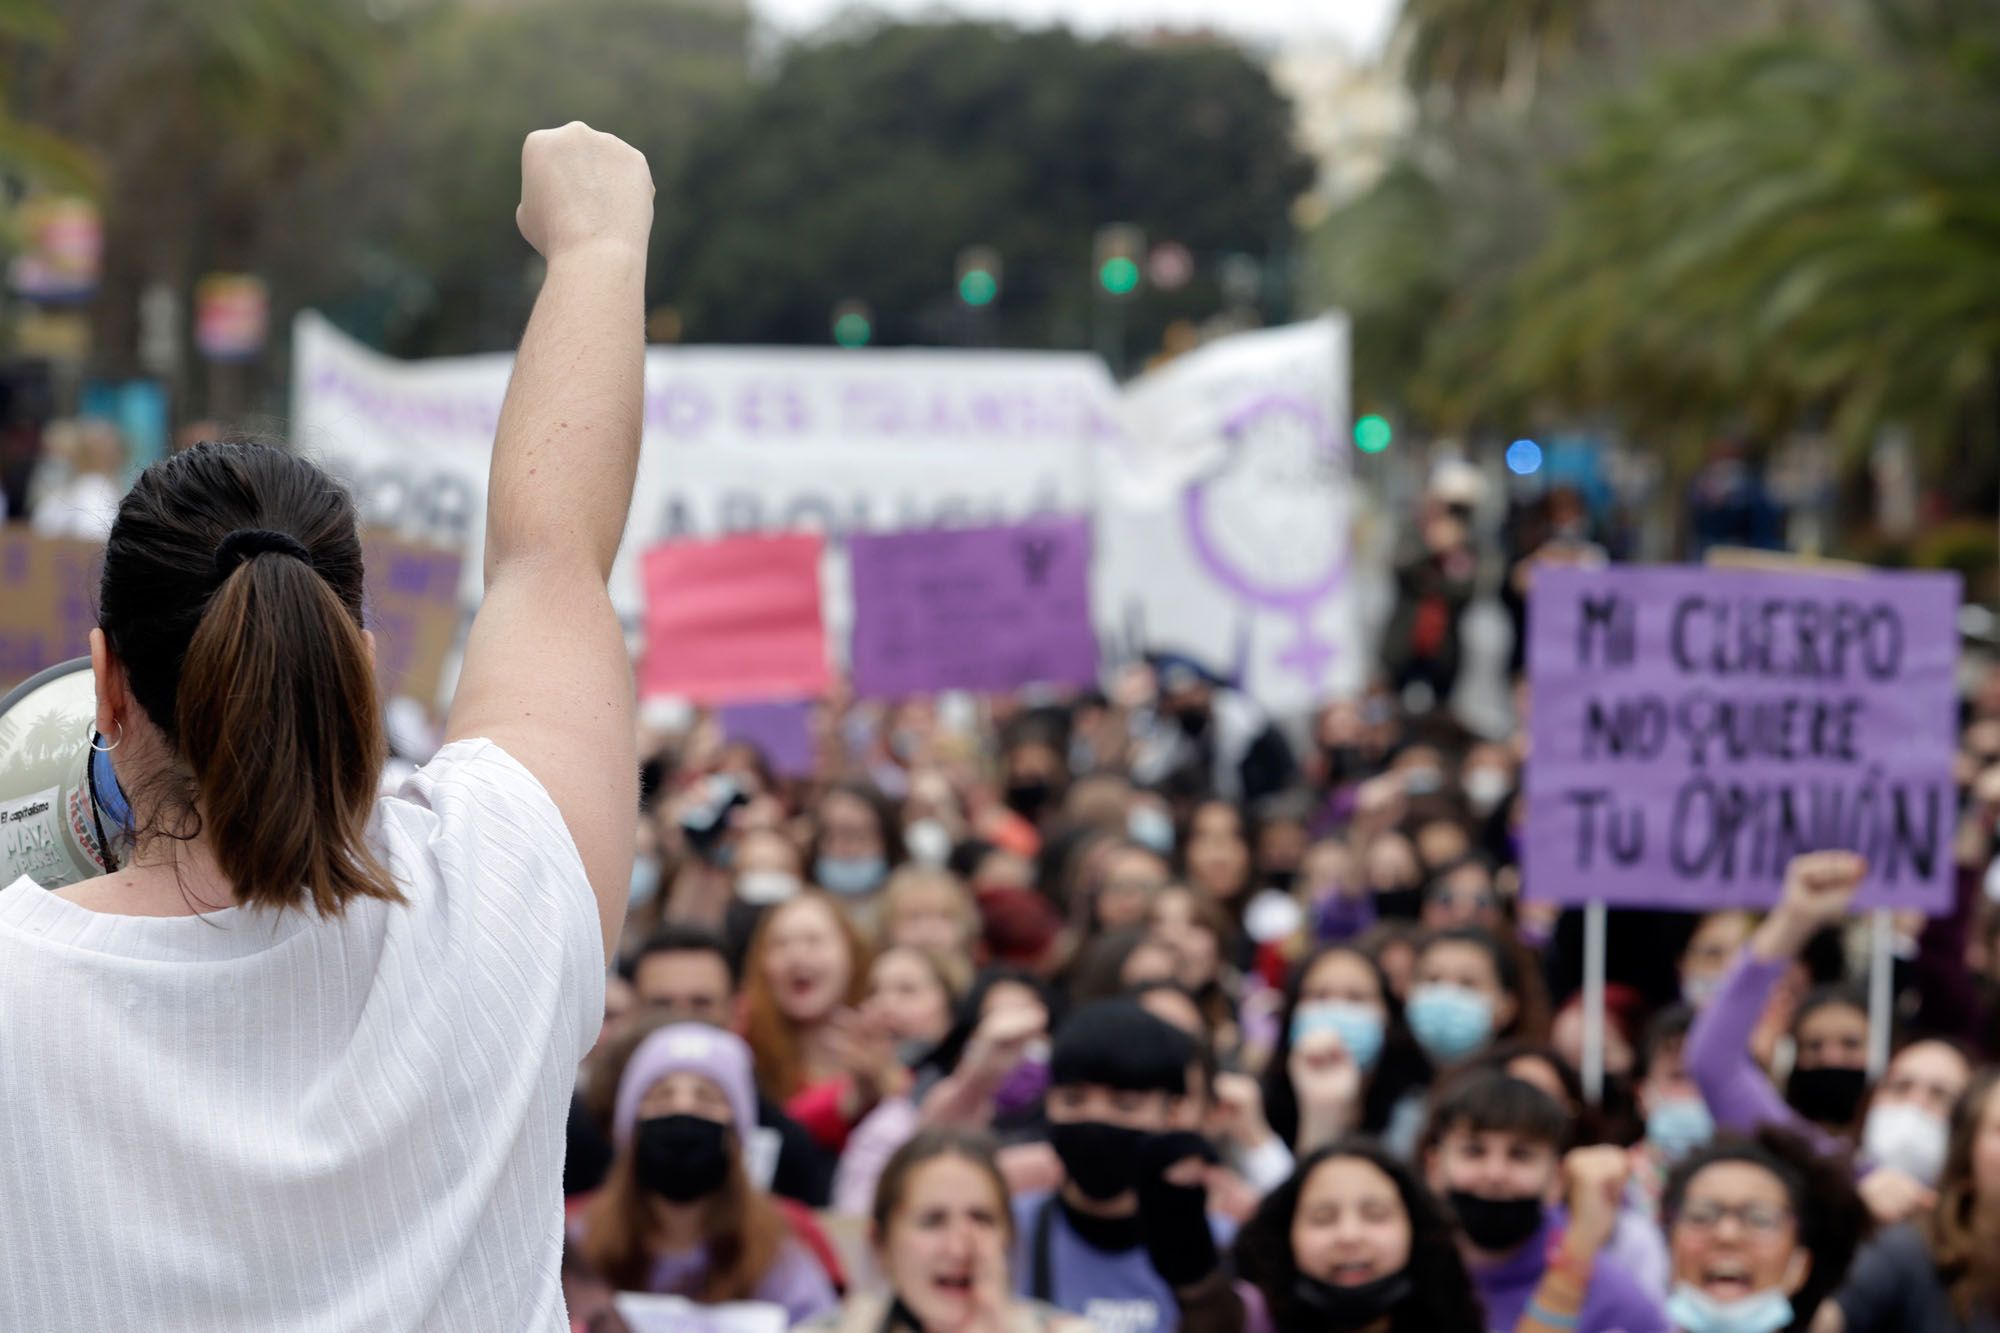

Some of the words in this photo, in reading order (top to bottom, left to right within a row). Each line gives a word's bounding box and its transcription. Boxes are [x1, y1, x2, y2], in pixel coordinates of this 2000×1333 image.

[1576, 589, 1637, 666] MI
[1669, 594, 1905, 682] CUERPO
[1581, 693, 1668, 762] NO
[10, 802, 49, 822] capitalismo
